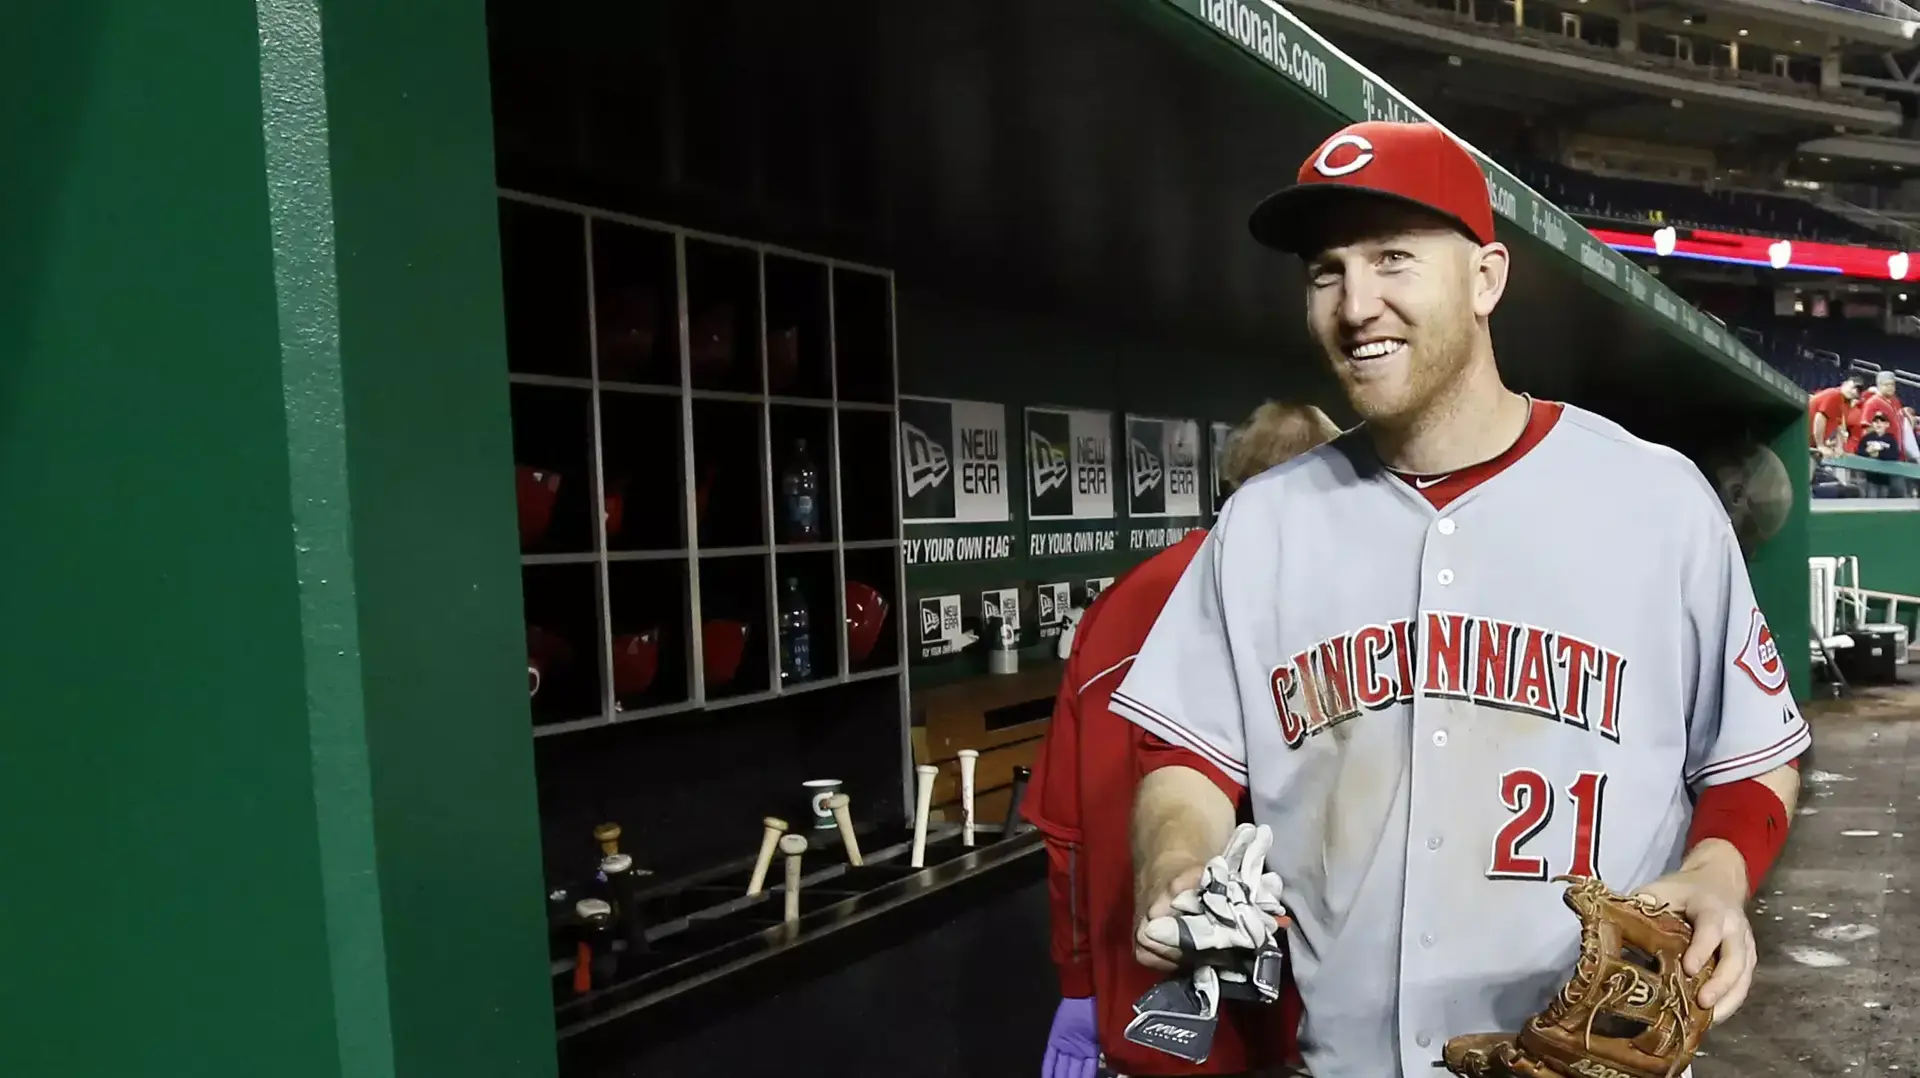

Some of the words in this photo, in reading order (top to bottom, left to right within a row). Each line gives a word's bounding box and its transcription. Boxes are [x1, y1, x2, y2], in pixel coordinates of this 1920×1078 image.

[1313, 134, 1375, 178] C
[961, 428, 998, 460] NEW
[963, 463, 1000, 494] ERA
[1079, 466, 1107, 494] ERA
[1170, 469, 1194, 495] ERA
[924, 538, 954, 563] YOUR
[957, 536, 983, 560] OWN
[985, 535, 1010, 559] FLAG
[1031, 533, 1046, 555] FLY
[1048, 532, 1072, 554] YOUR
[1074, 531, 1094, 553] OWN
[1095, 530, 1115, 551] FLAG
[1130, 529, 1144, 548] FLY
[1145, 528, 1165, 548] YOUR
[1269, 610, 1628, 750] CINCINNATI
[1485, 767, 1608, 882] 21
